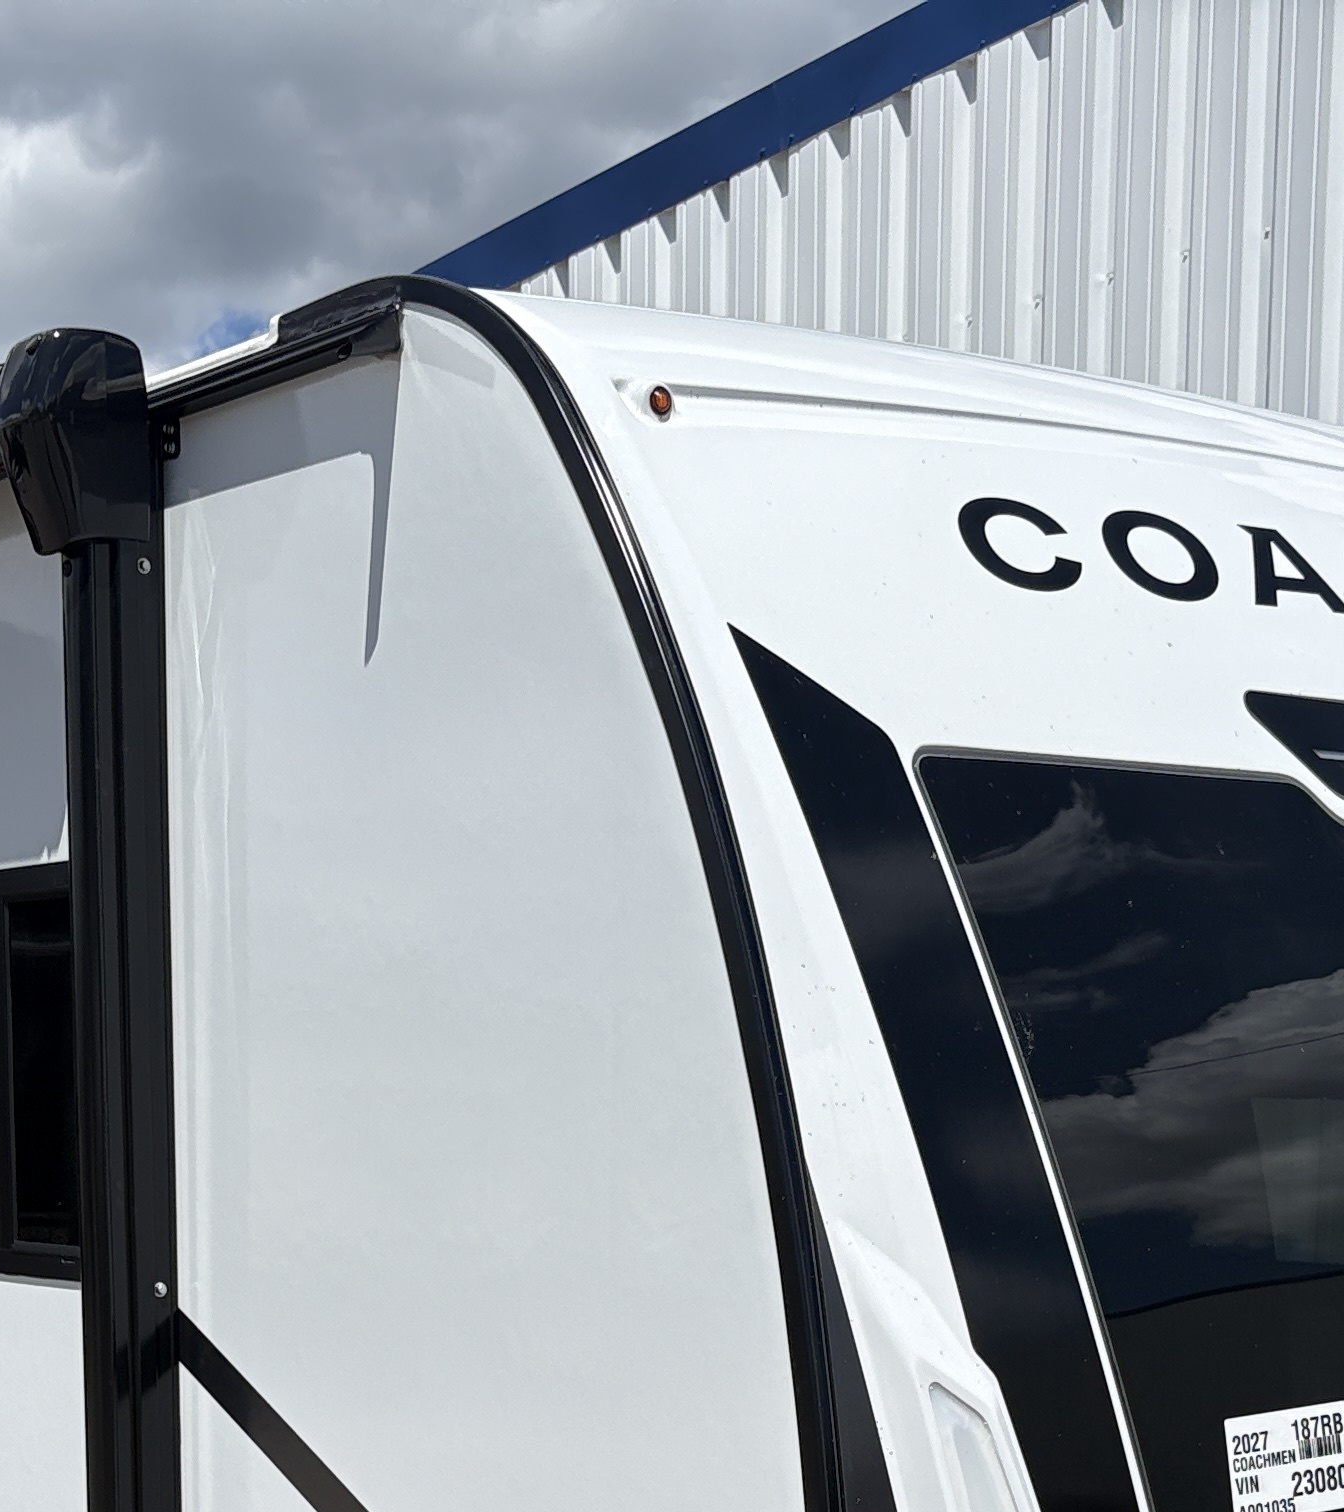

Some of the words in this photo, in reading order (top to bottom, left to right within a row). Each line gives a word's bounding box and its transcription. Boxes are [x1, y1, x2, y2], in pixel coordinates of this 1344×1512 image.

[1232, 1431, 1269, 1455] 2027
[1291, 1412, 1344, 1440] 187RB
[1233, 1449, 1296, 1473] COACHMEN
[1235, 1475, 1259, 1495] VIN
